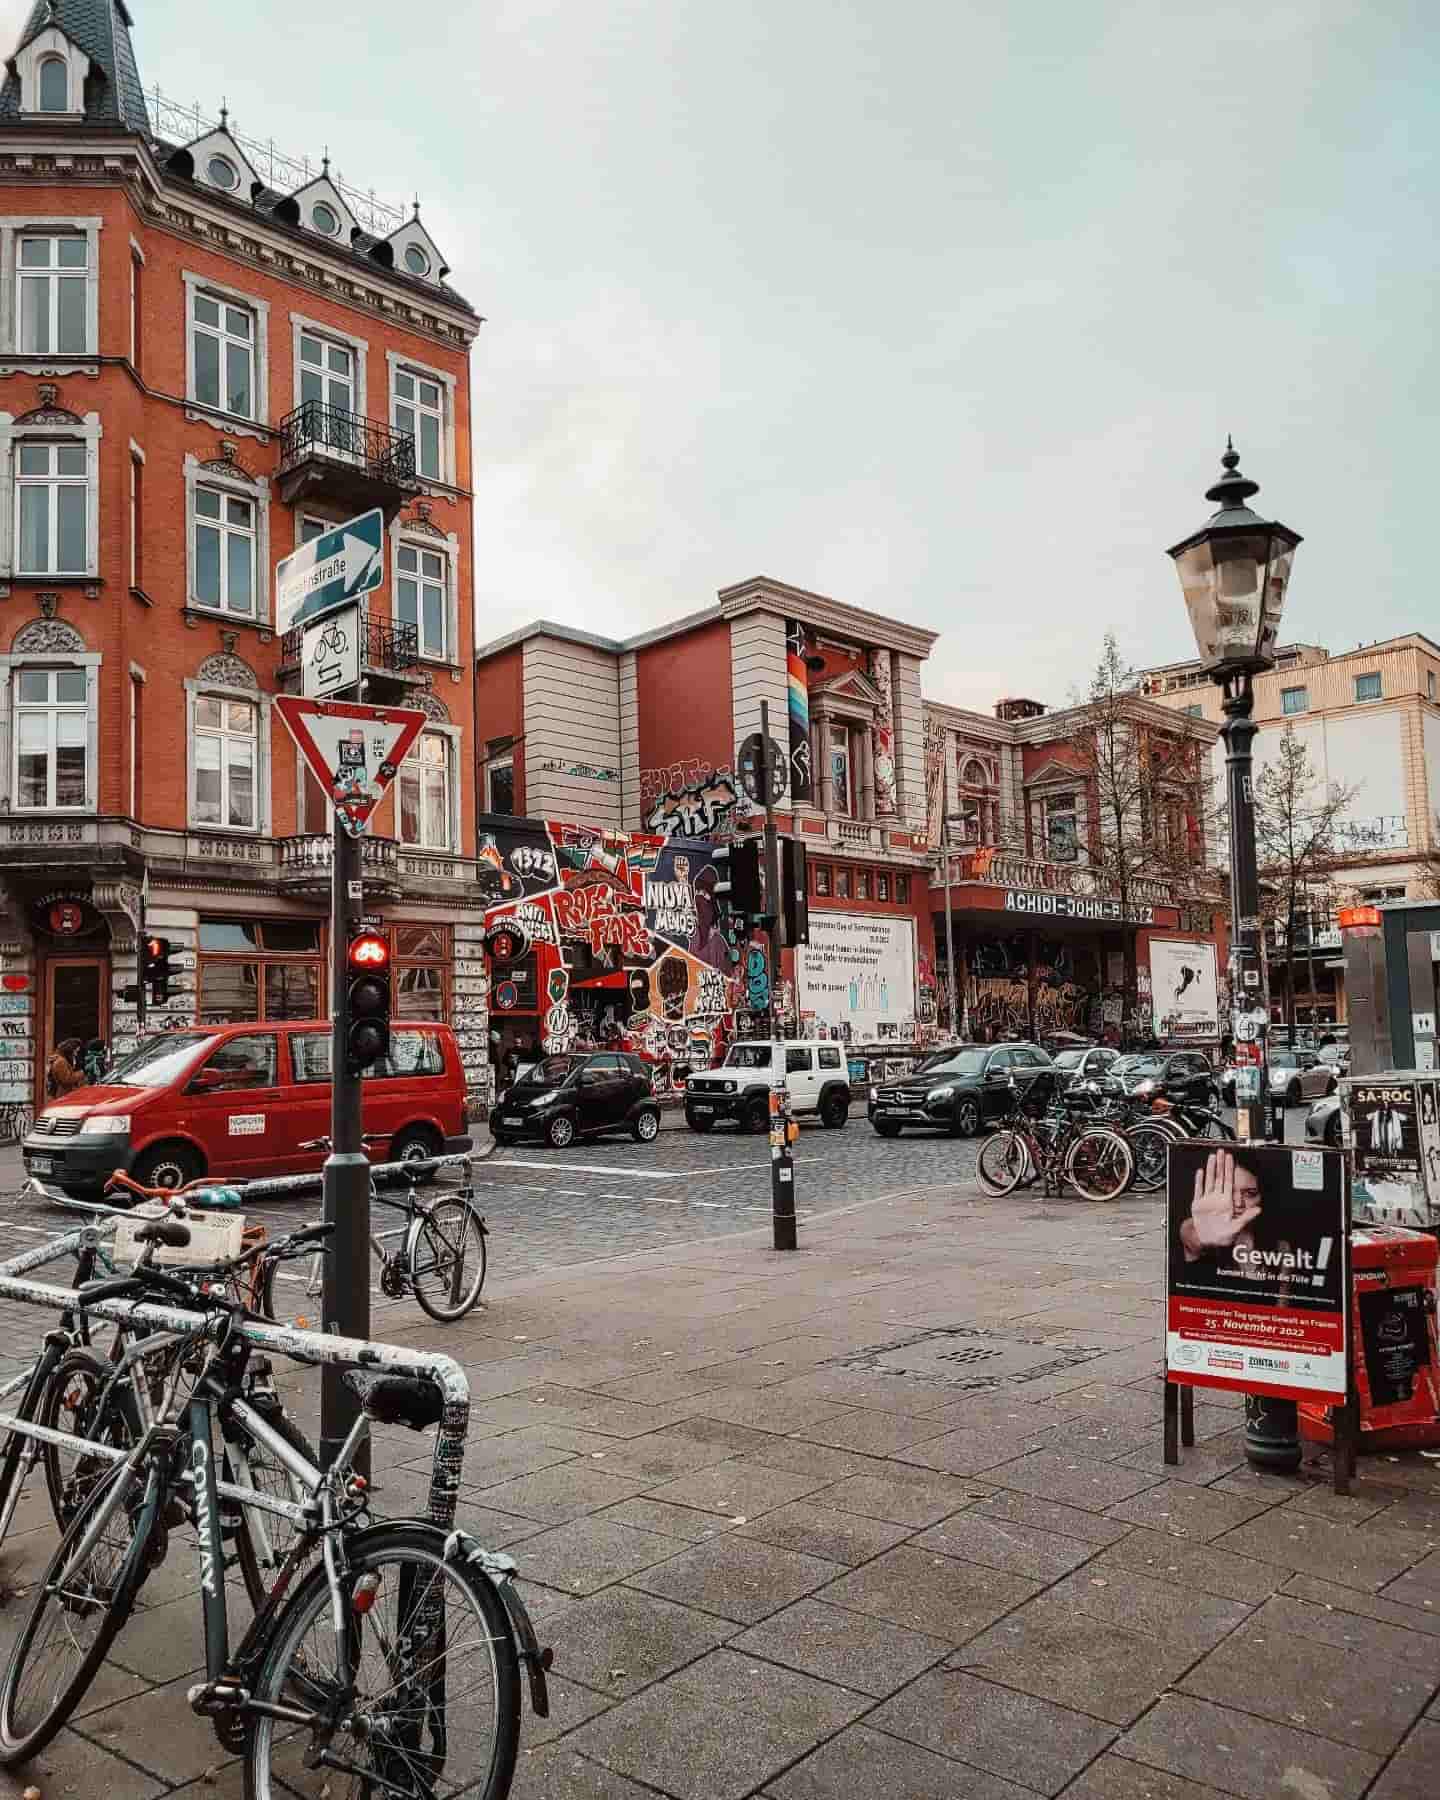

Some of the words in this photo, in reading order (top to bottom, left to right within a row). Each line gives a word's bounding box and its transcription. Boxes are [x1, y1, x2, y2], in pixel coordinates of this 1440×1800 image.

[1357, 1090, 1412, 1103] SA-ROC
[1204, 1318, 1221, 1330] 25.
[1223, 1320, 1276, 1335] November
[1279, 1326, 1305, 1337] 2022
